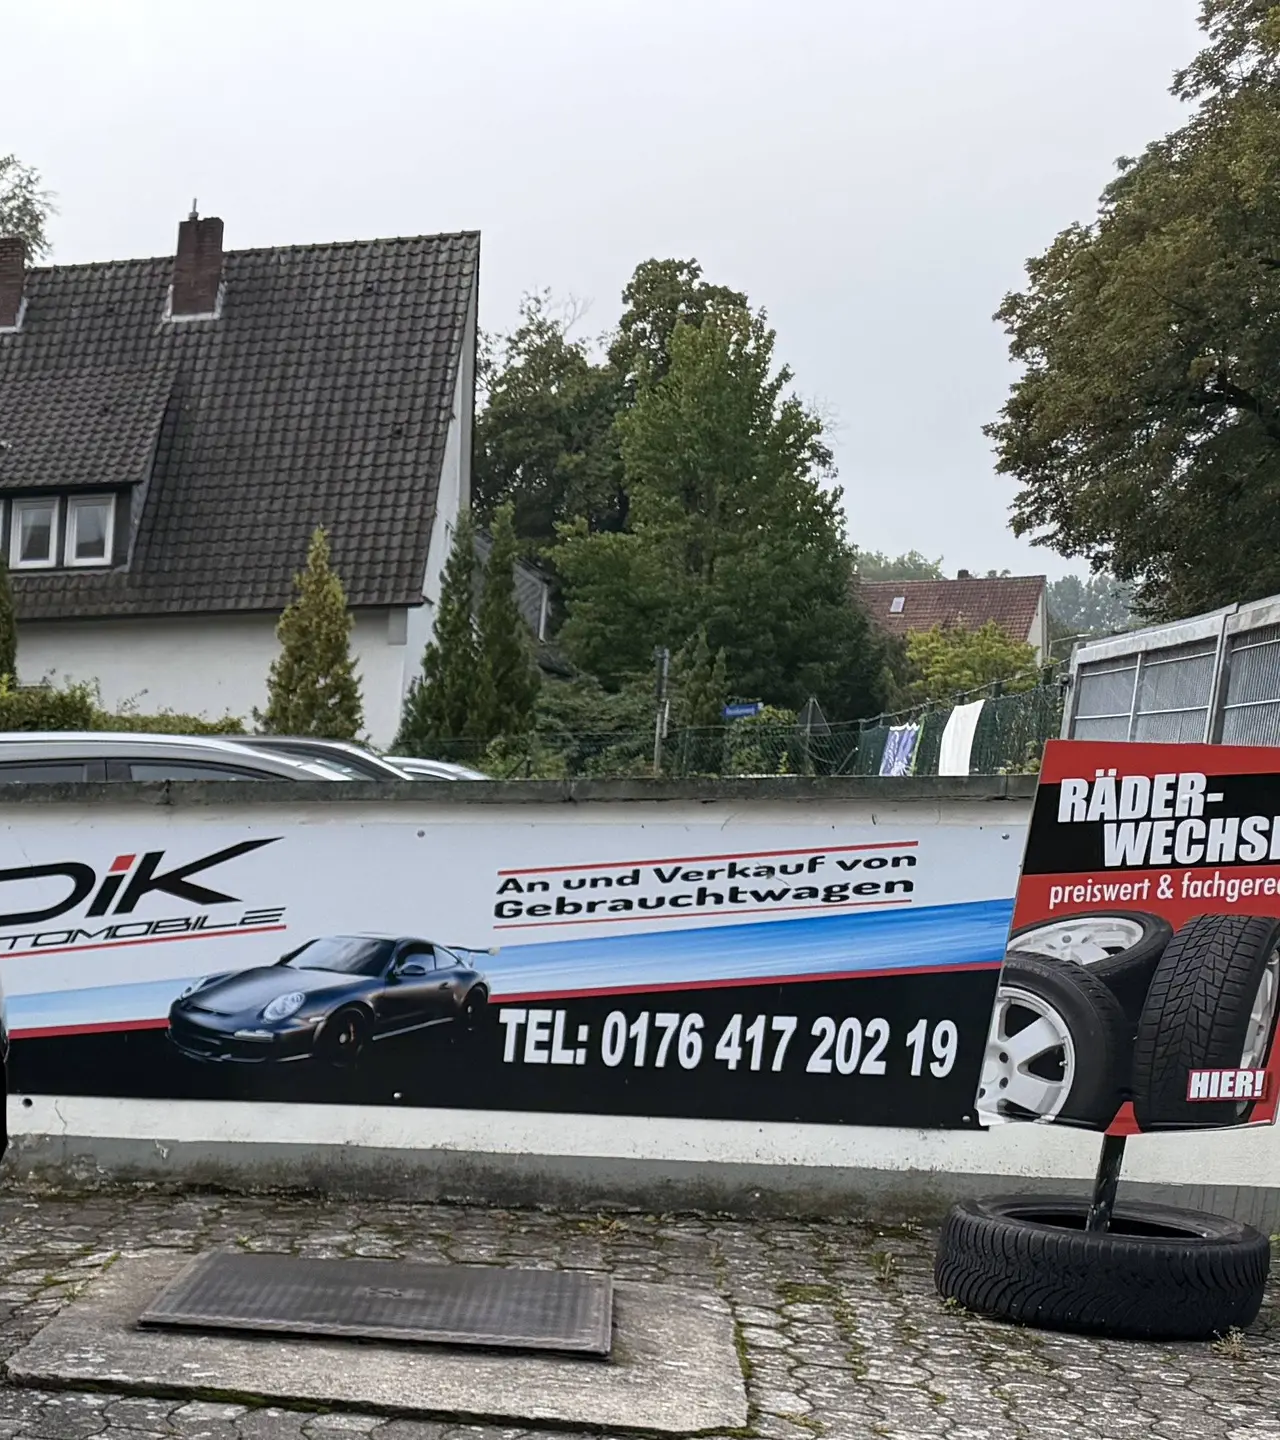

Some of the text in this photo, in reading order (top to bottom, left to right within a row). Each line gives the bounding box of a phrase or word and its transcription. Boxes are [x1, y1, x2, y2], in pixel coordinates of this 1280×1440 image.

[1057, 768, 1224, 823] RÄDER-
[496, 855, 917, 895] An und Verkauf von
[1048, 876, 1151, 910] preiswert
[1156, 873, 1175, 900] &
[493, 876, 915, 920] Gebrauchtwagen
[499, 1008, 959, 1078] TEL: 0176 417 202 19
[1189, 1069, 1265, 1099] HIER!
